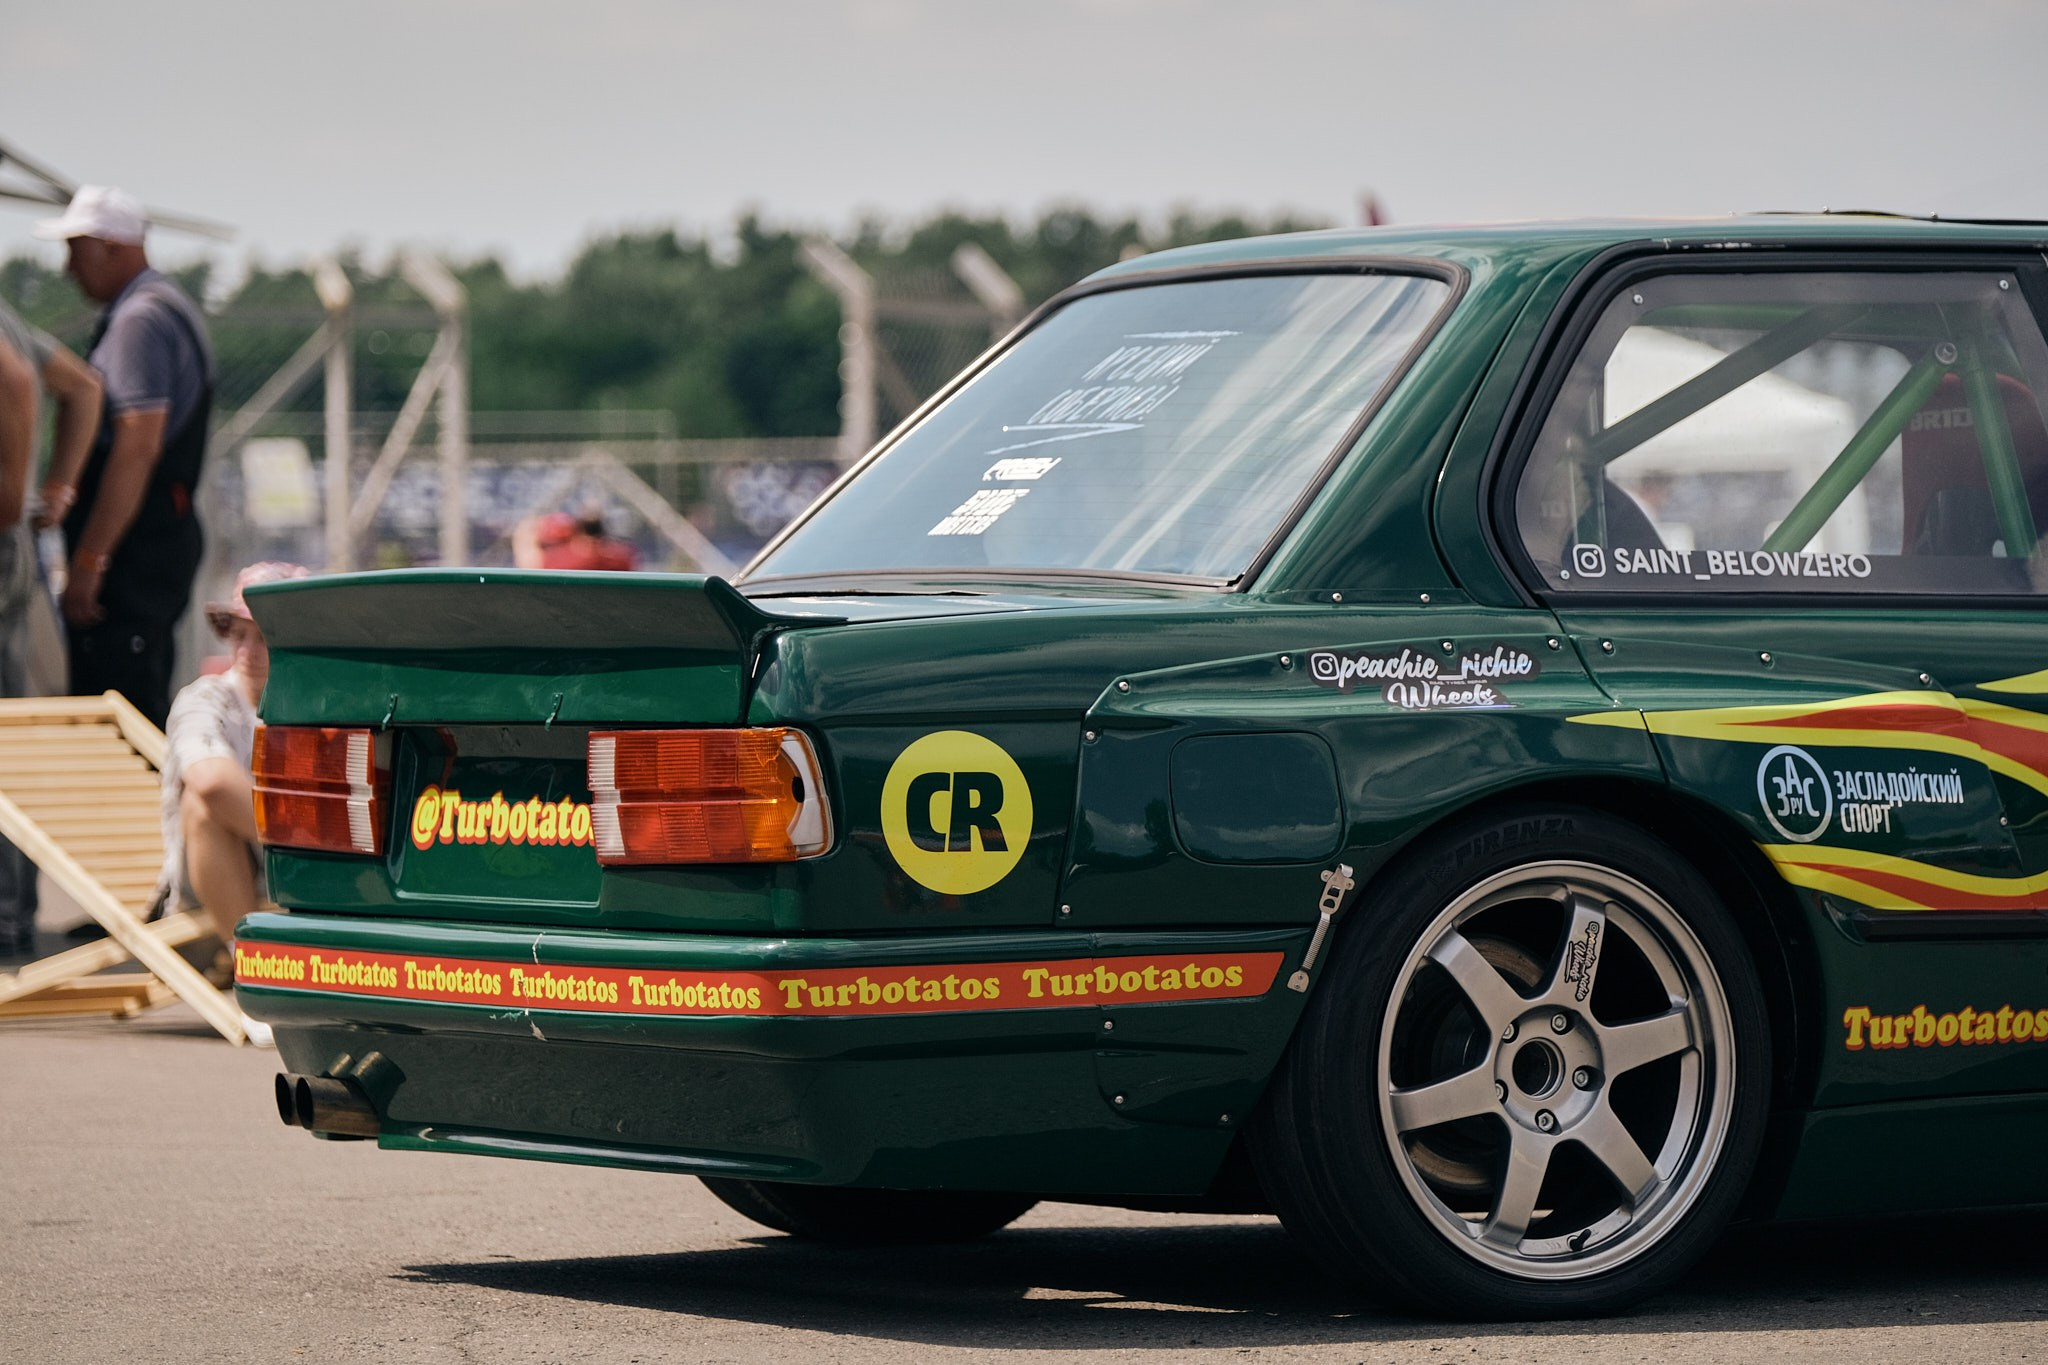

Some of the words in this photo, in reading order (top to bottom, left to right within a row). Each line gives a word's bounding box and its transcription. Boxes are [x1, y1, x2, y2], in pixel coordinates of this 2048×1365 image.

[1614, 547, 1873, 582] SAINT_BELOWZERO
[1387, 681, 1498, 709] Wheels
[1833, 766, 1965, 808] ЗАСЛАДОЙСКИЙ
[412, 784, 595, 851] @Turbotato
[906, 771, 1009, 853] CR
[1840, 803, 1892, 833] СПОРТ
[1454, 818, 1576, 868] FIRENZA
[235, 948, 305, 981] Turbotatos
[308, 954, 398, 989] Turbotatos
[404, 961, 502, 996] Turbotatos
[509, 967, 619, 1004] Turbotatos
[628, 974, 762, 1010] Turbotatos
[778, 967, 1001, 1010] Turbotatos
[1022, 961, 1244, 999] Turbotatos
